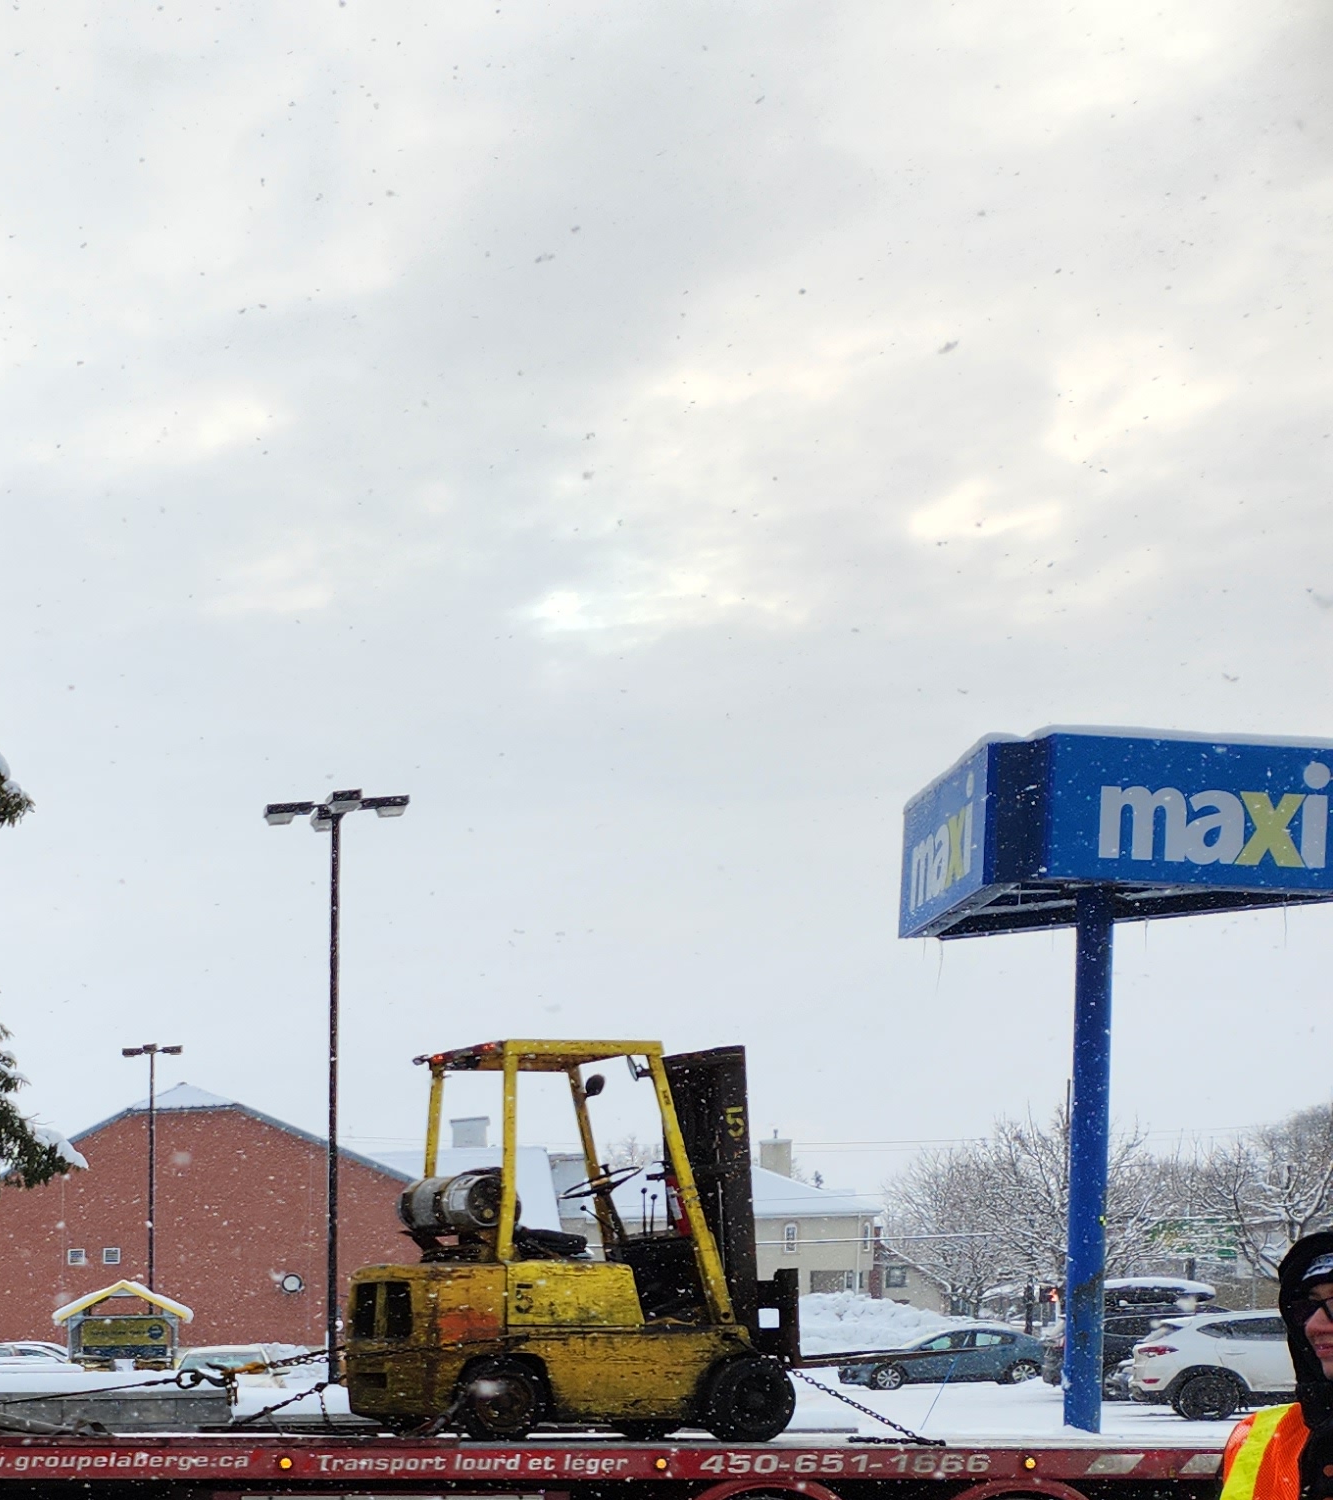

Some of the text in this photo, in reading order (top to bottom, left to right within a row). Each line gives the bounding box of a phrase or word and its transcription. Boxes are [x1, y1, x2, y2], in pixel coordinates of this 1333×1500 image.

[1098, 762, 1331, 869] maxi
[909, 771, 975, 913] maxi
[726, 1106, 744, 1138] 5
[515, 1283, 533, 1314] 5
[318, 1454, 446, 1475] Transport
[454, 1453, 521, 1471] lourd
[528, 1456, 555, 1471] et
[699, 1453, 990, 1474] 450-651-1666
